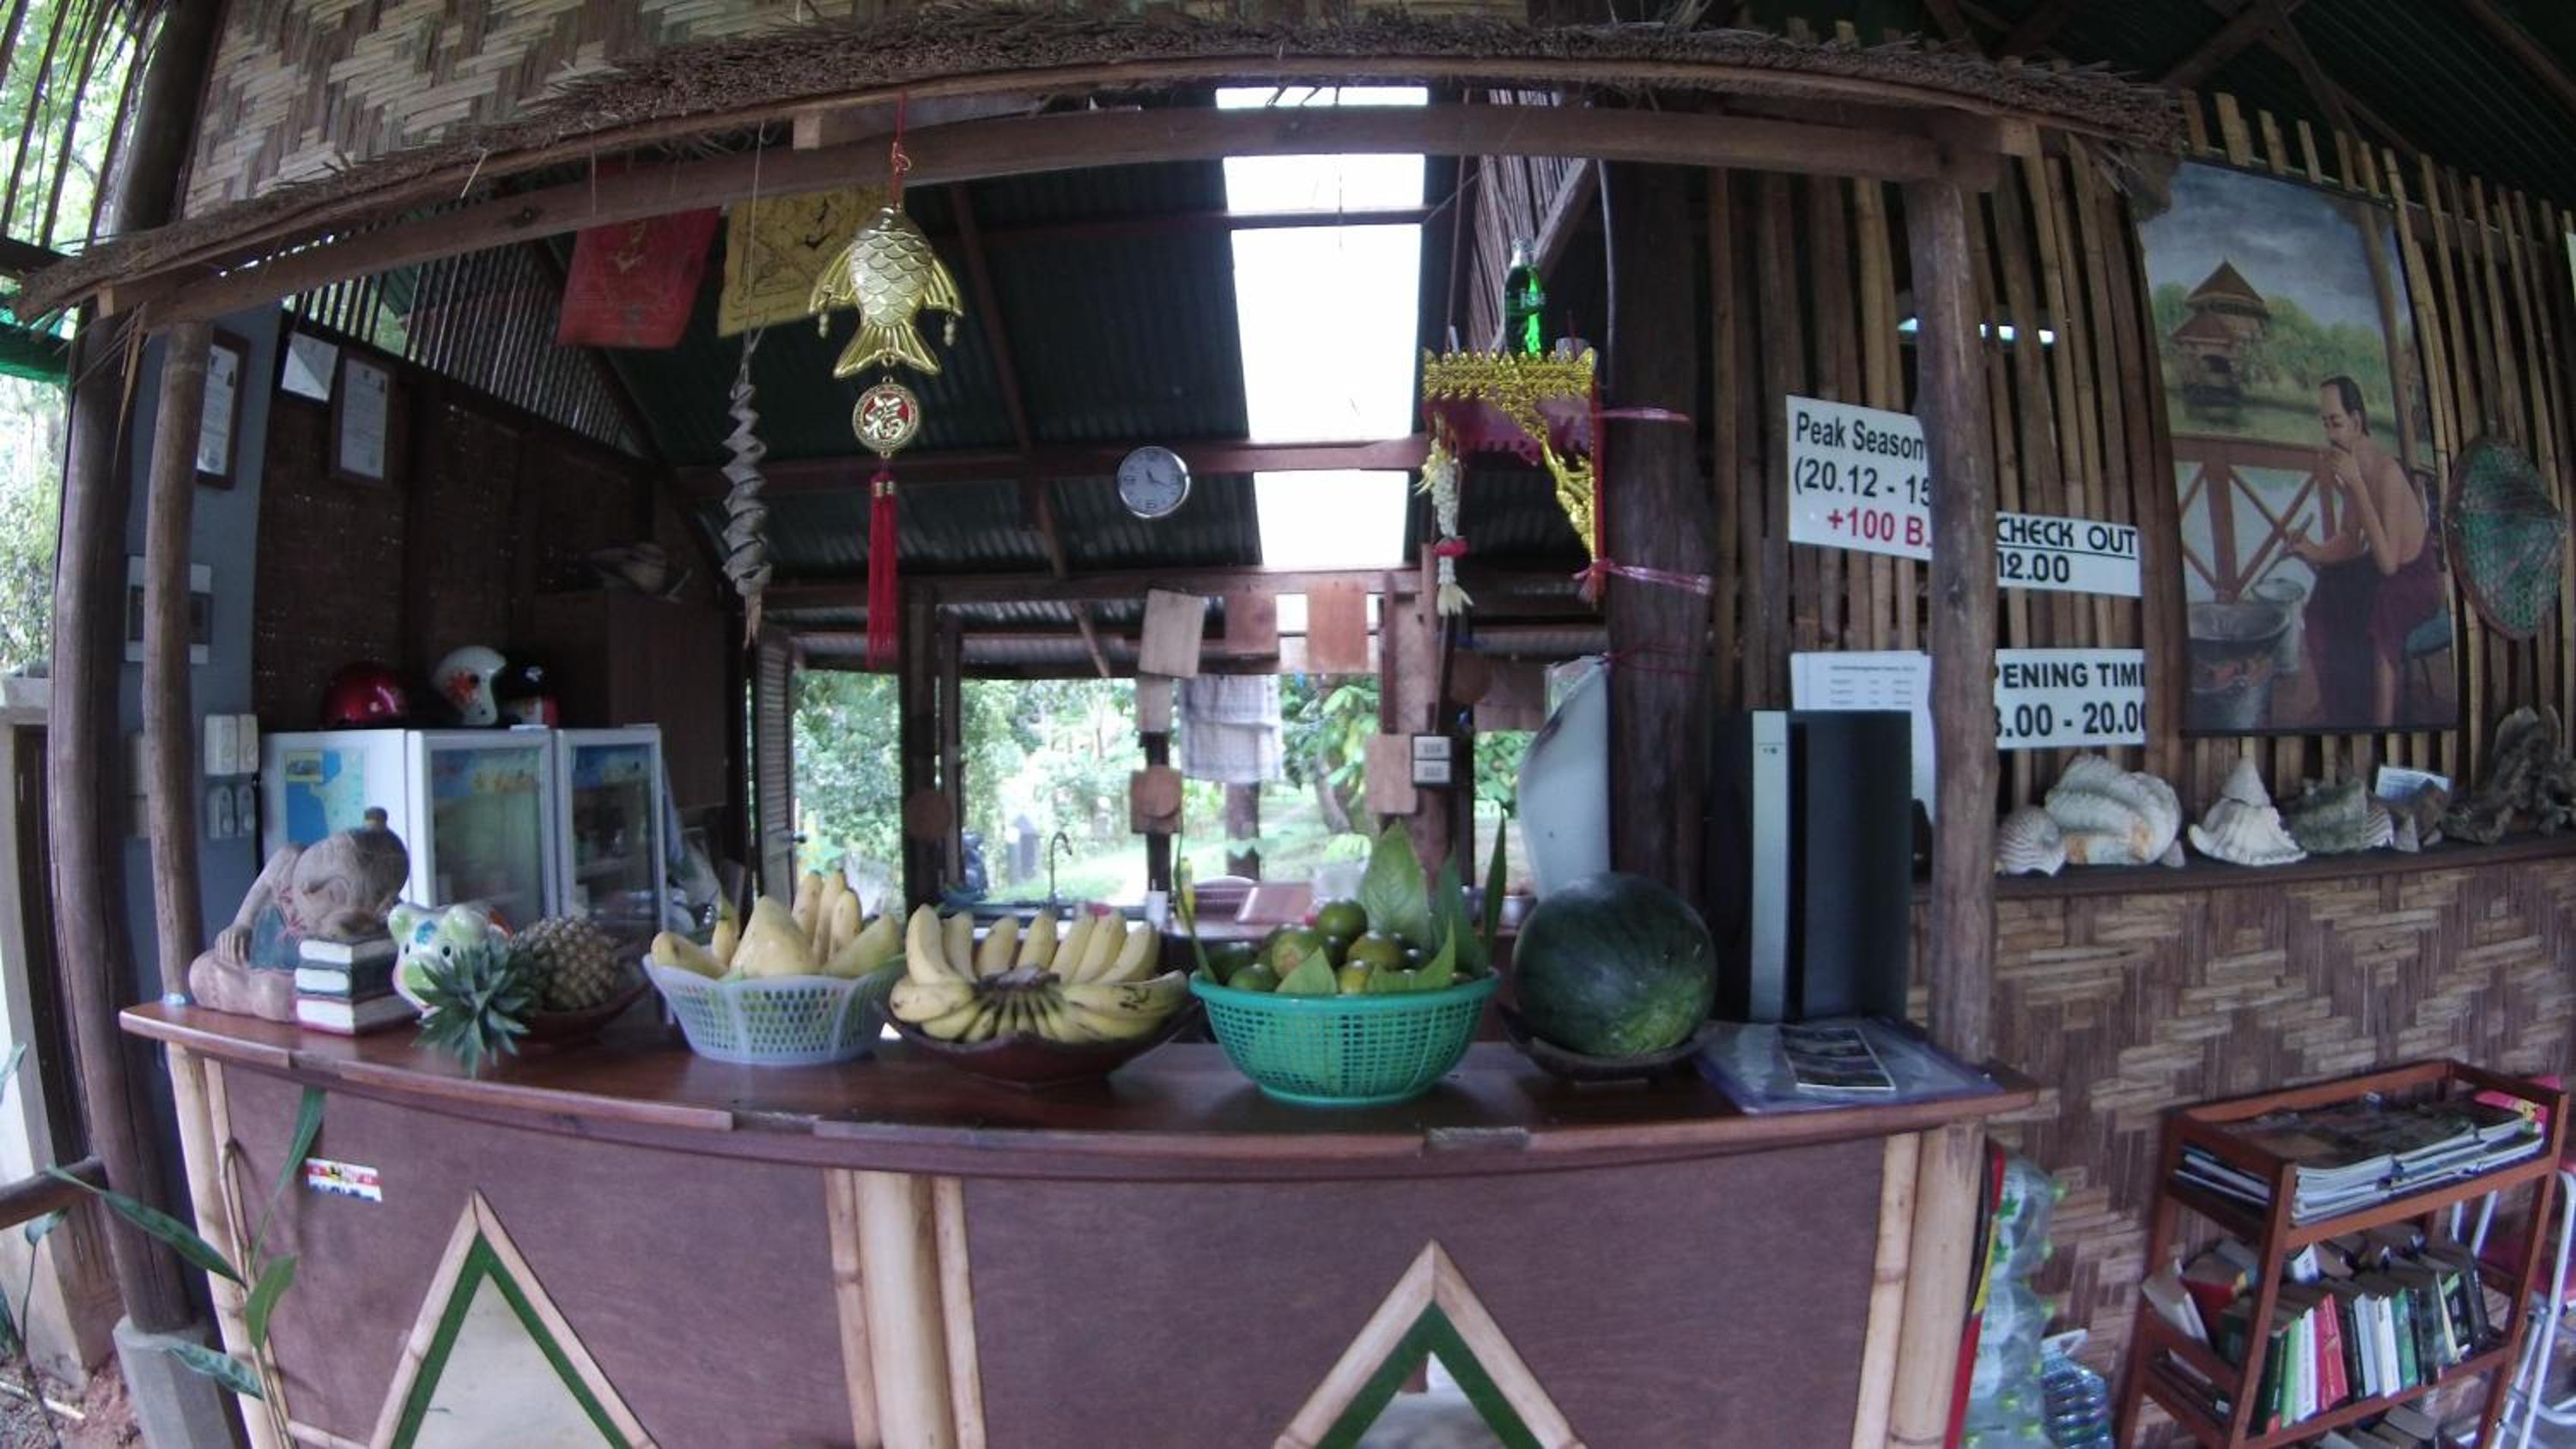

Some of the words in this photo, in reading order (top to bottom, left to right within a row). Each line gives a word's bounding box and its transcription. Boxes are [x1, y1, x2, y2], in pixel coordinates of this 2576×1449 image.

[1795, 411, 1845, 449] Peak
[1852, 419, 1924, 461] Season
[1795, 456, 1878, 498] (20.12
[1827, 506, 1896, 543] +100
[1996, 517, 2074, 548] CHECK
[2087, 524, 2136, 554] OUT
[1996, 551, 2070, 583] 12.00
